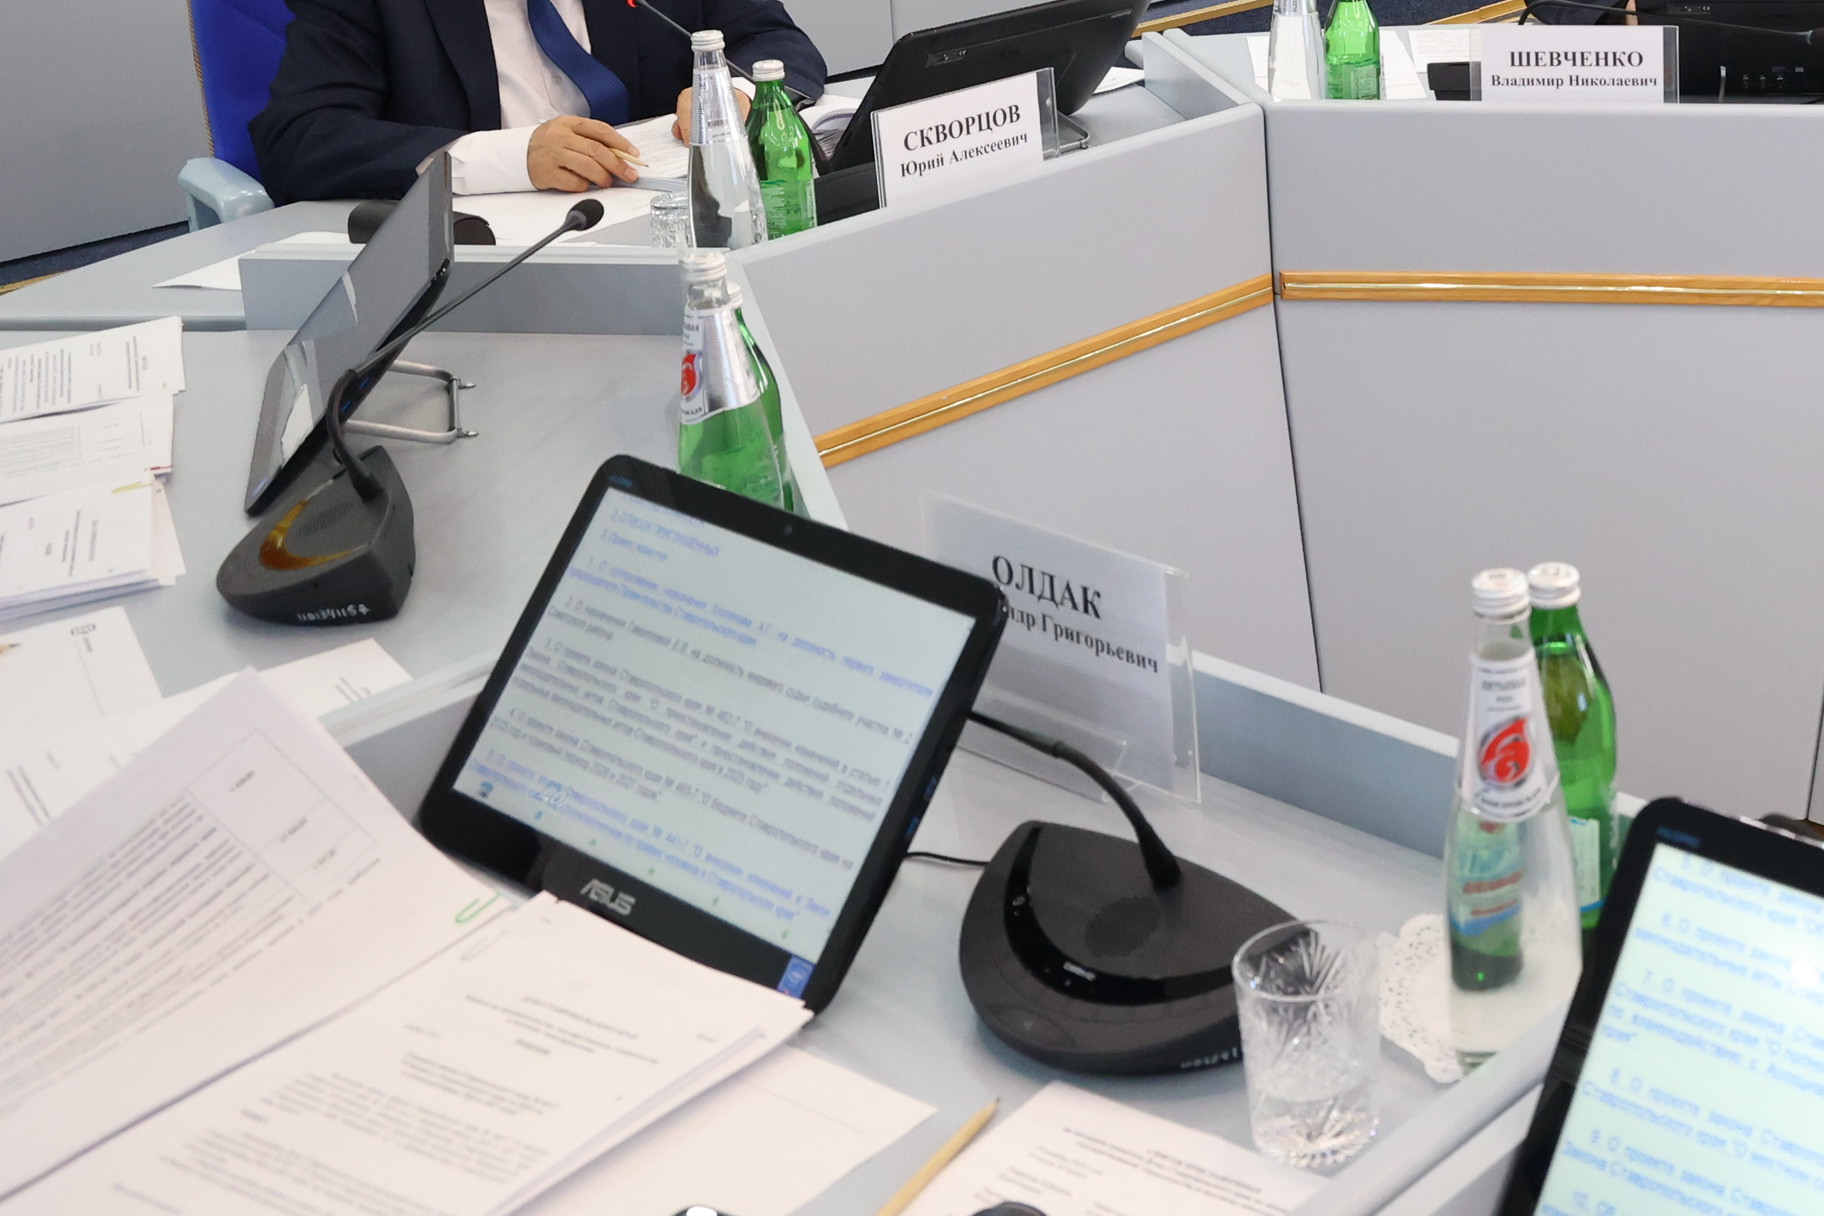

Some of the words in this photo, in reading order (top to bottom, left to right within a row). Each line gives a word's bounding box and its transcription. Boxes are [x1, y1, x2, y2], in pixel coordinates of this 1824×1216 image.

[1509, 50, 1644, 67] ШЕВЧЕНКО
[1491, 74, 1564, 89] Владимир
[1569, 75, 1657, 87] Николаевич
[903, 104, 1021, 151] СКВОРЦОВ
[900, 152, 945, 177] Юрий
[949, 133, 1028, 164] Алексеевич
[992, 555, 1101, 620] ОЛДАК
[1041, 613, 1158, 673] Григорьевич
[579, 878, 636, 916] ASUS
